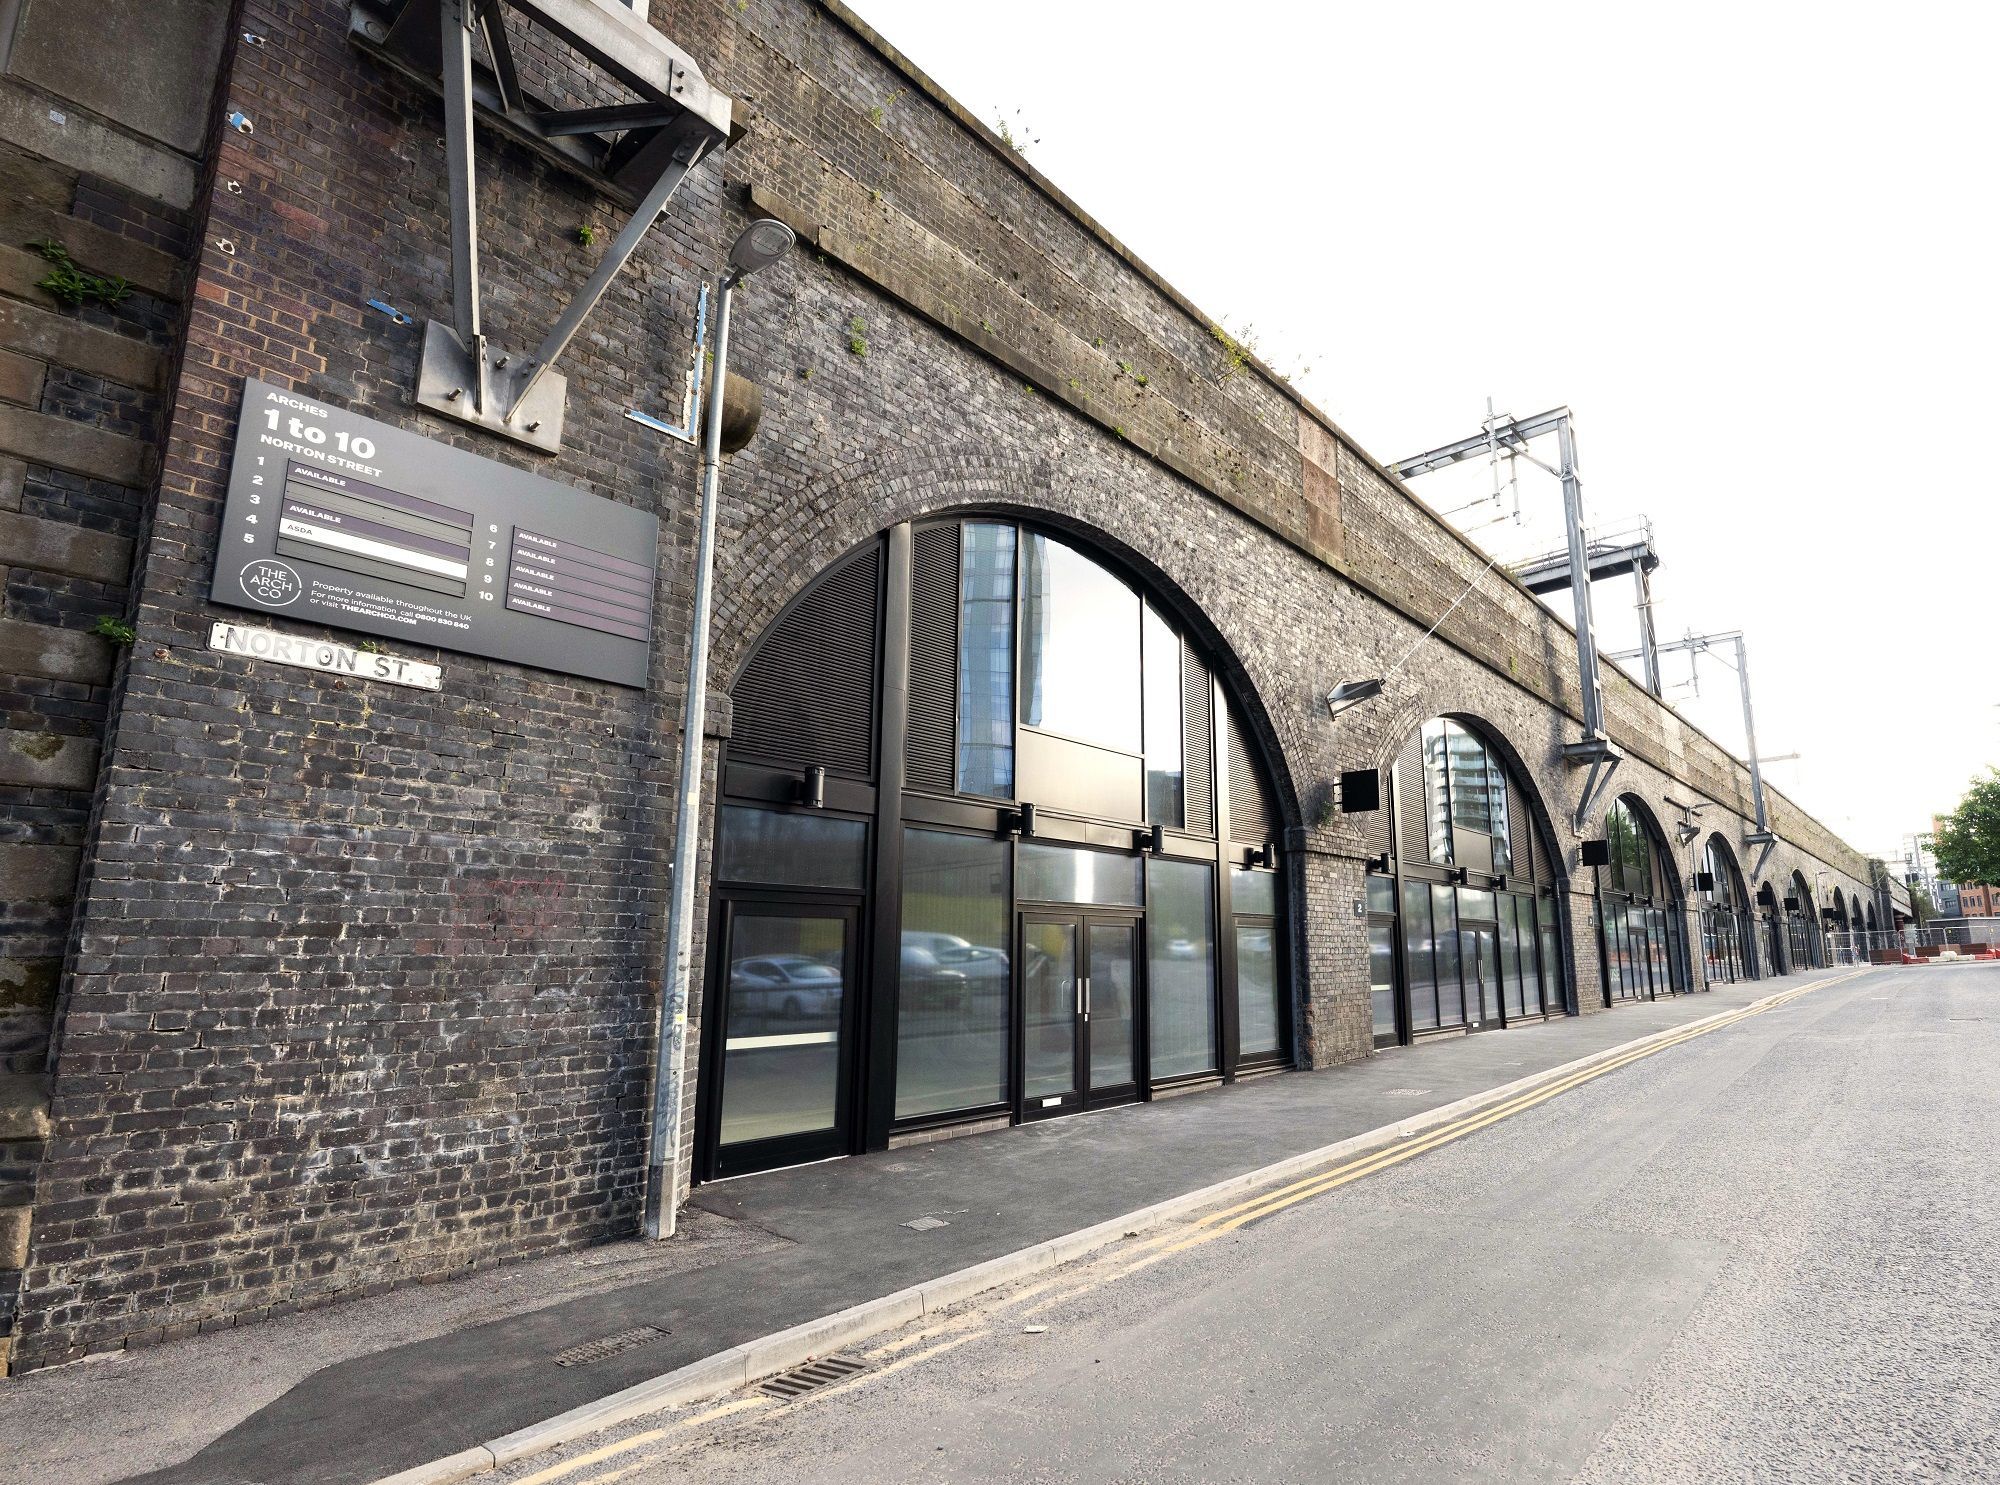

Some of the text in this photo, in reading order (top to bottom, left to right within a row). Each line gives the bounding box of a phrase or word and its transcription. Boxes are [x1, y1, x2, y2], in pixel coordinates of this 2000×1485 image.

[266, 392, 328, 418] ARCHES
[264, 409, 376, 459] 1 to 10
[260, 434, 383, 478] NORTON STREET
[252, 474, 264, 486] 2
[257, 456, 347, 487] 1 AVAILABLE
[249, 494, 341, 524] 3 AVAILABLE
[245, 514, 313, 536] 4 ASDA
[489, 524, 557, 548] 6 AVAILABLE
[243, 533, 255, 544] 5
[488, 540, 556, 565] 7 AVAILABLE
[259, 566, 288, 581] THE
[485, 557, 555, 581] 8 AVAILABLE
[250, 574, 293, 592] ARCH
[258, 587, 282, 599] CO
[483, 574, 553, 597] 9 AVAILABLE
[311, 590, 470, 630] For more information call 0800 830 840
[312, 580, 472, 622] Property available throughout the UK
[321, 600, 339, 609] visit
[340, 603, 417, 625] THEARCHCO.COM
[479, 591, 551, 613] 10 AVAILABLE
[224, 627, 414, 683] NORTON ST.
